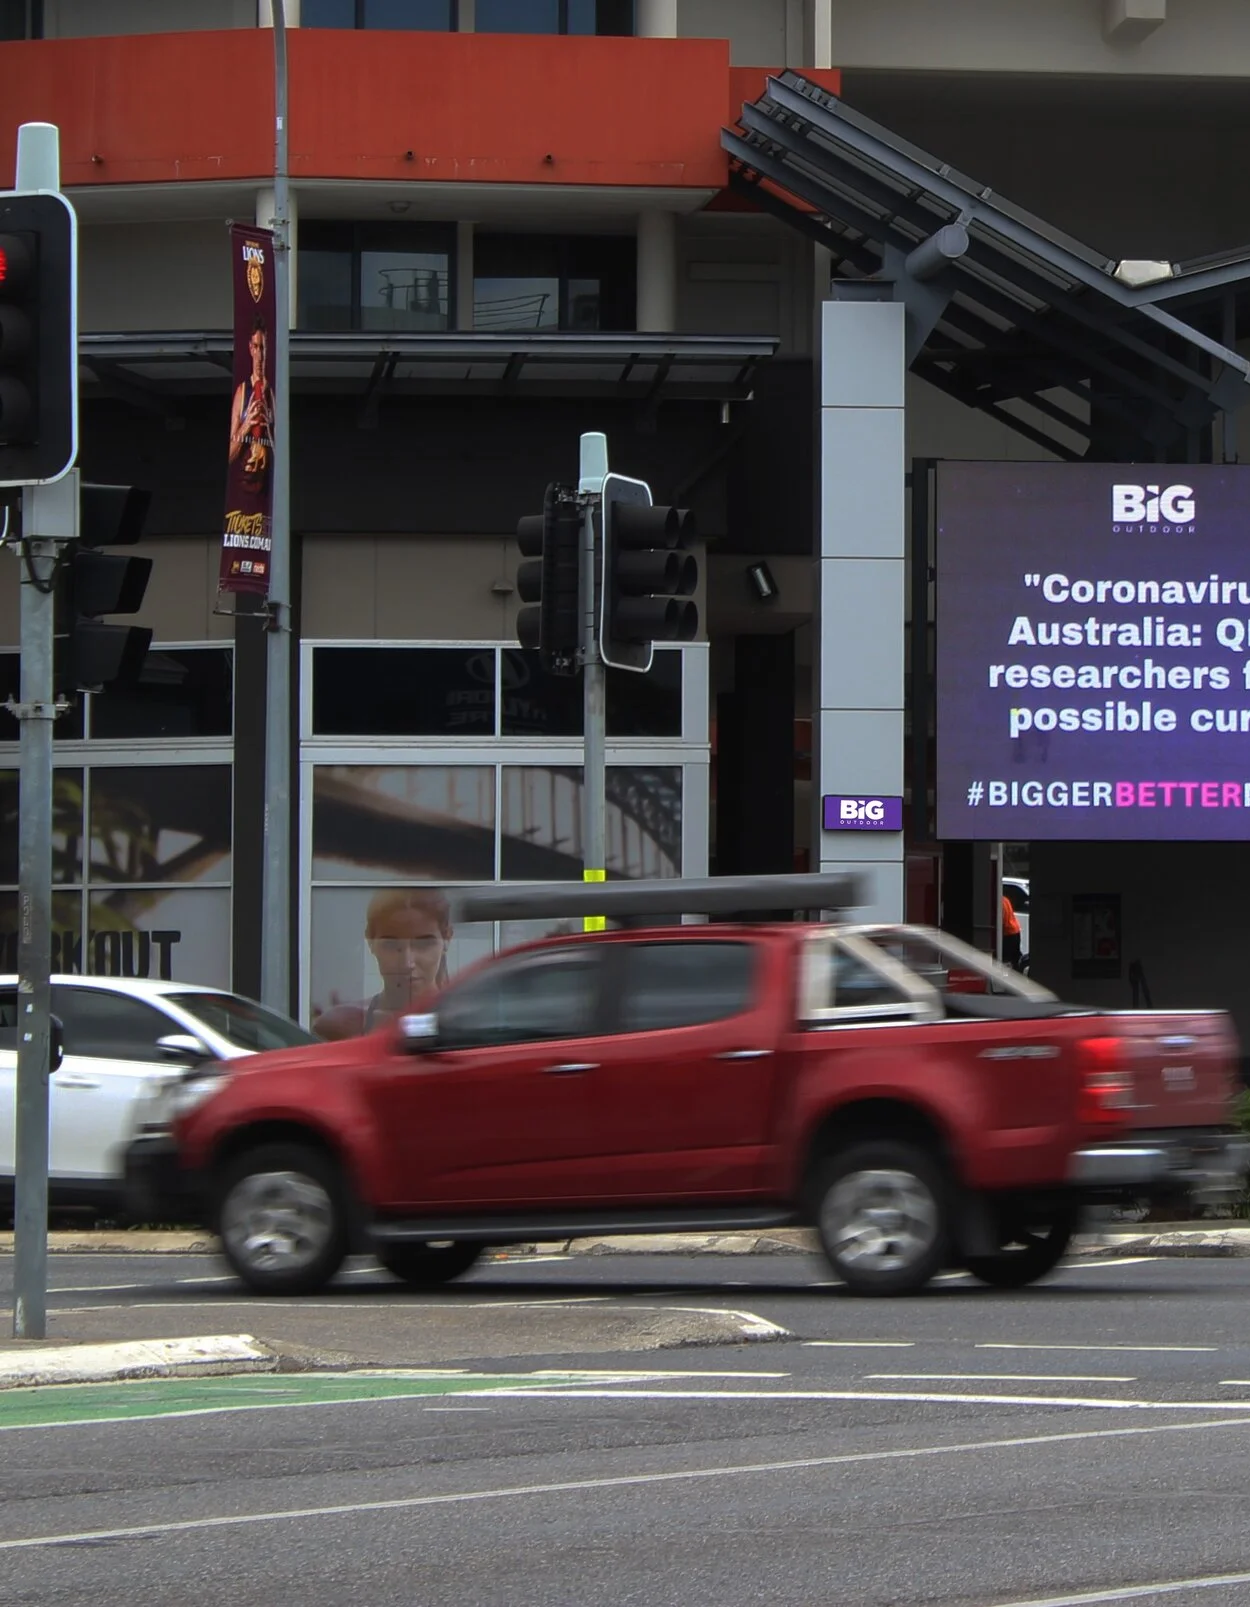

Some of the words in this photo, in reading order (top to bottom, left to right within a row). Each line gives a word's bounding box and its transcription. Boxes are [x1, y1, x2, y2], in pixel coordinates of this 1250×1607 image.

[242, 246, 265, 264] LIONS
[225, 510, 263, 535] TICKETS
[1112, 525, 1195, 533] OUTDOOR
[1007, 616, 1203, 647] Australia:
[989, 658, 1231, 689] researchers
[1009, 701, 1178, 738] possible
